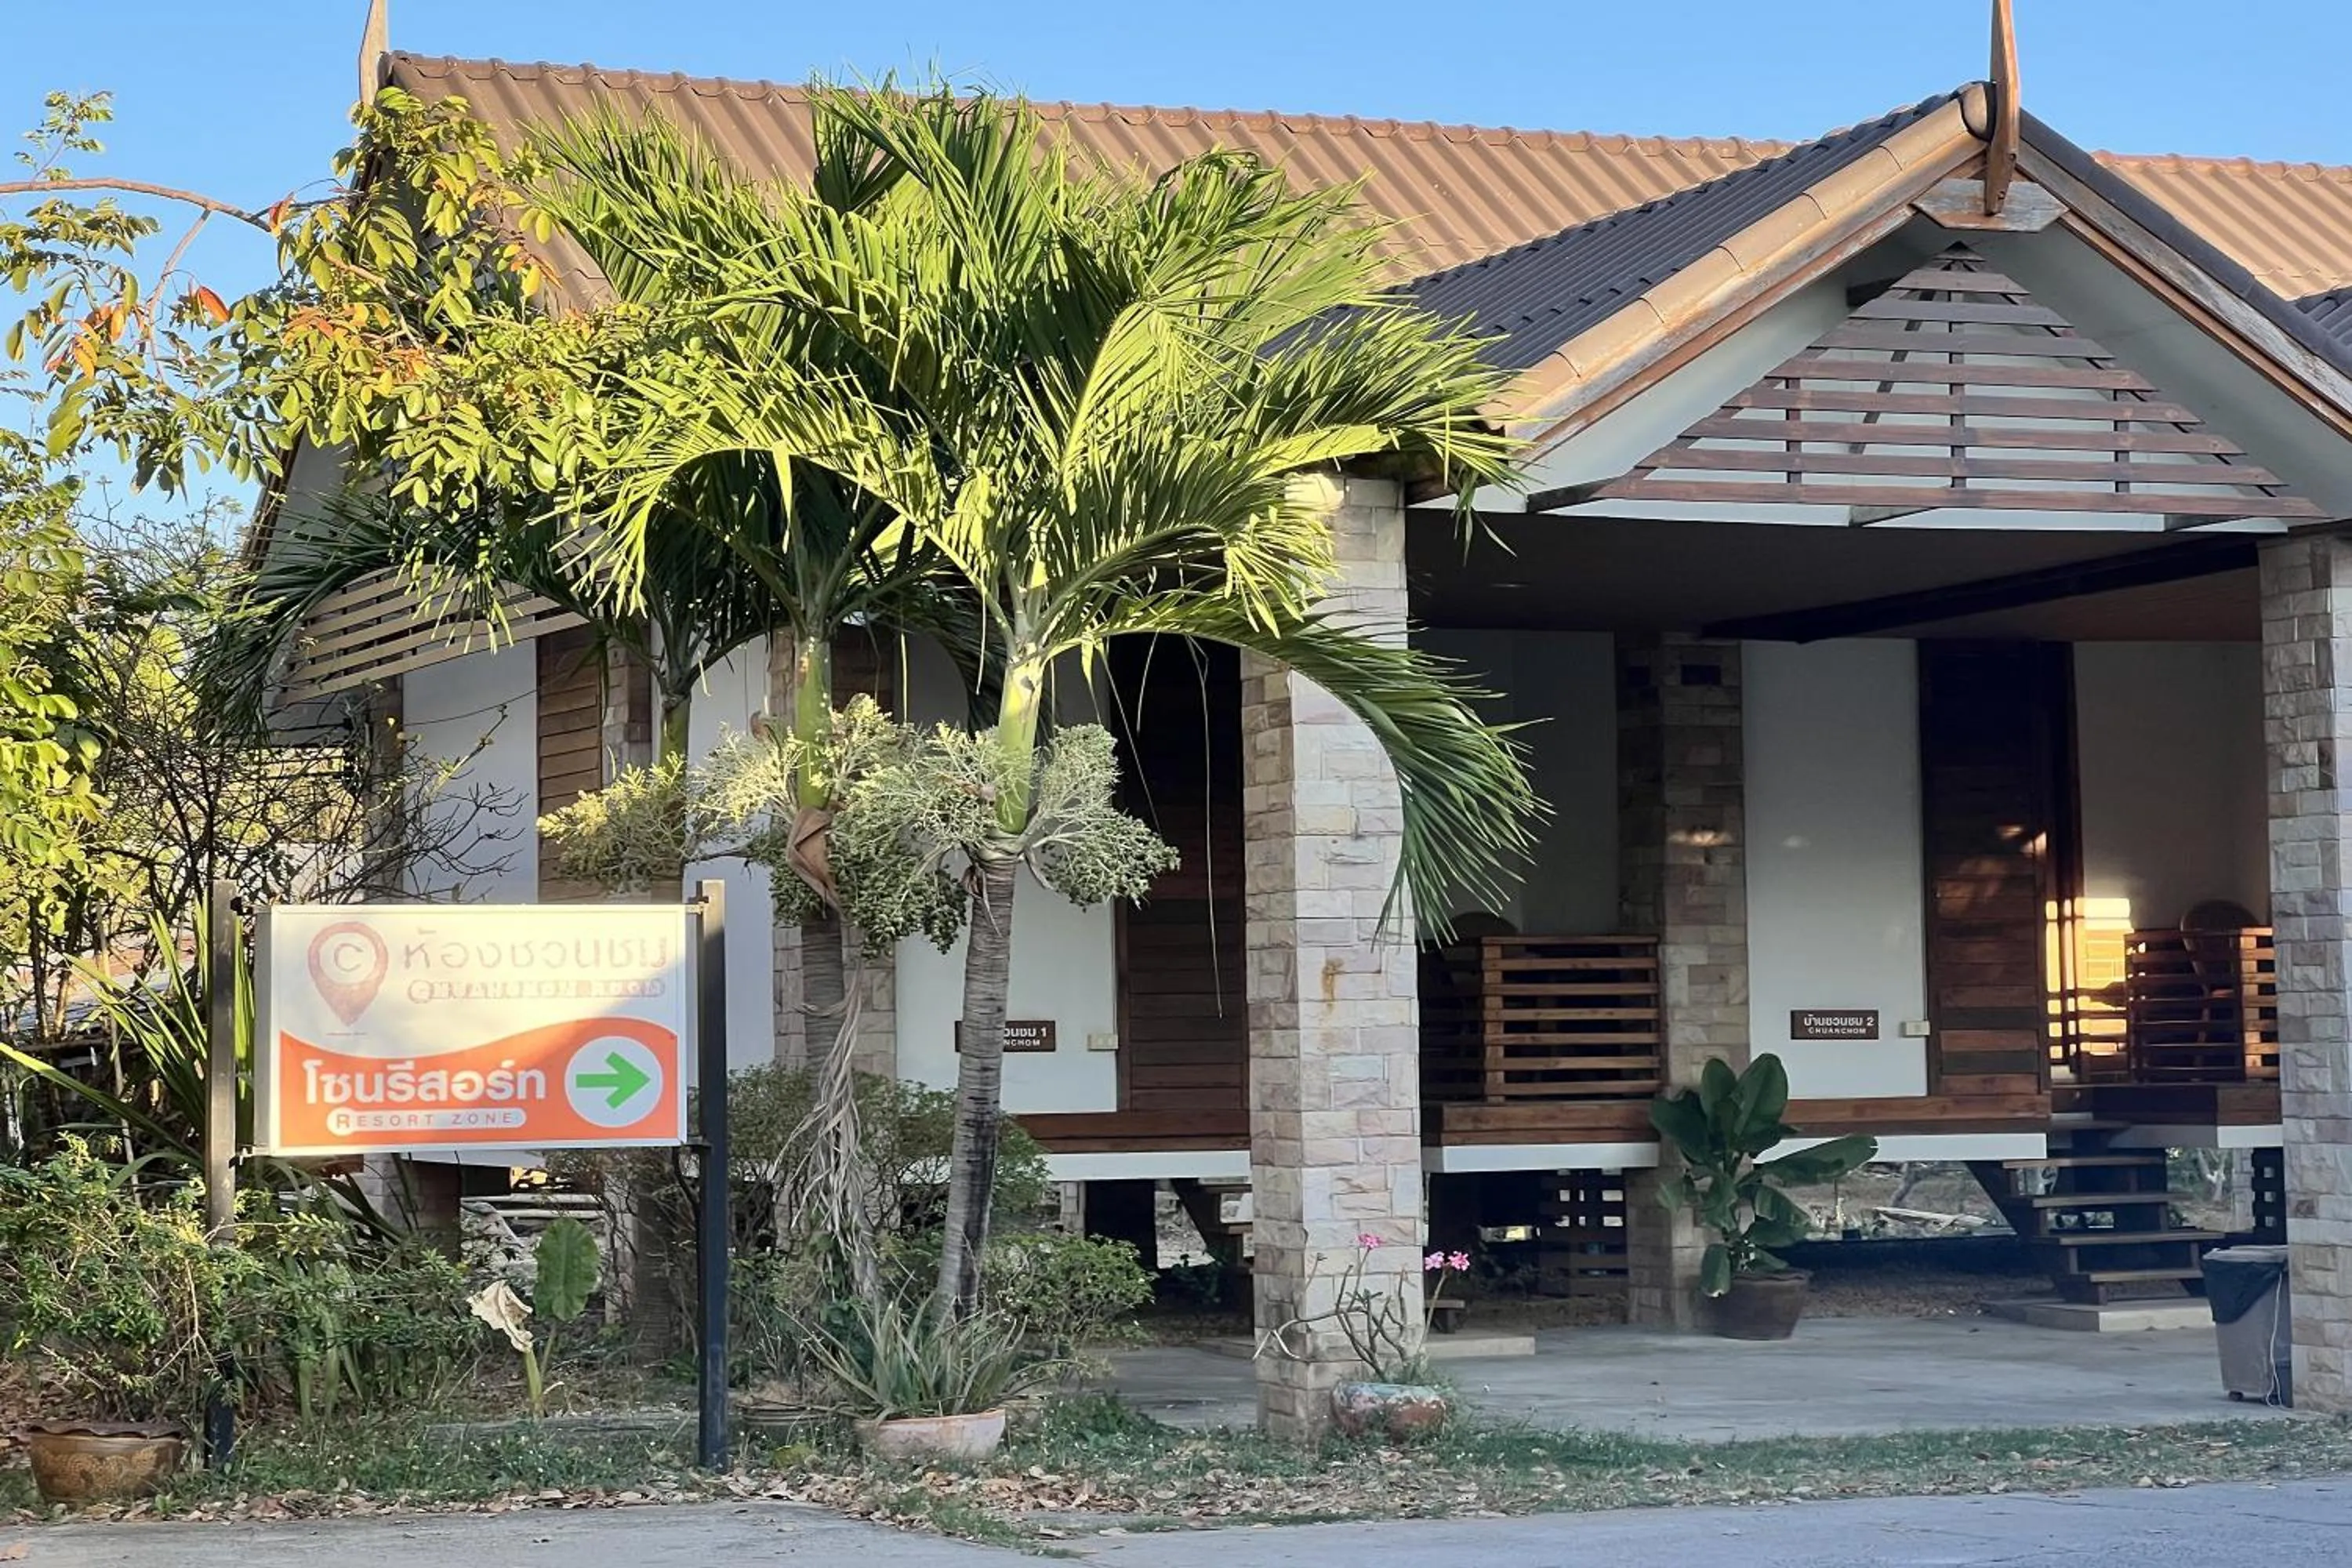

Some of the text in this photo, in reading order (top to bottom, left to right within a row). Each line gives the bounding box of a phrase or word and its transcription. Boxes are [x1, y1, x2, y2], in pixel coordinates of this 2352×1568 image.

[1804, 1014, 1875, 1026] บ้านชวนชม 2
[1040, 1026, 1047, 1036] 1
[303, 1058, 546, 1105] โซนรีสอร์ท
[336, 1112, 513, 1129] RESORT ZONE
